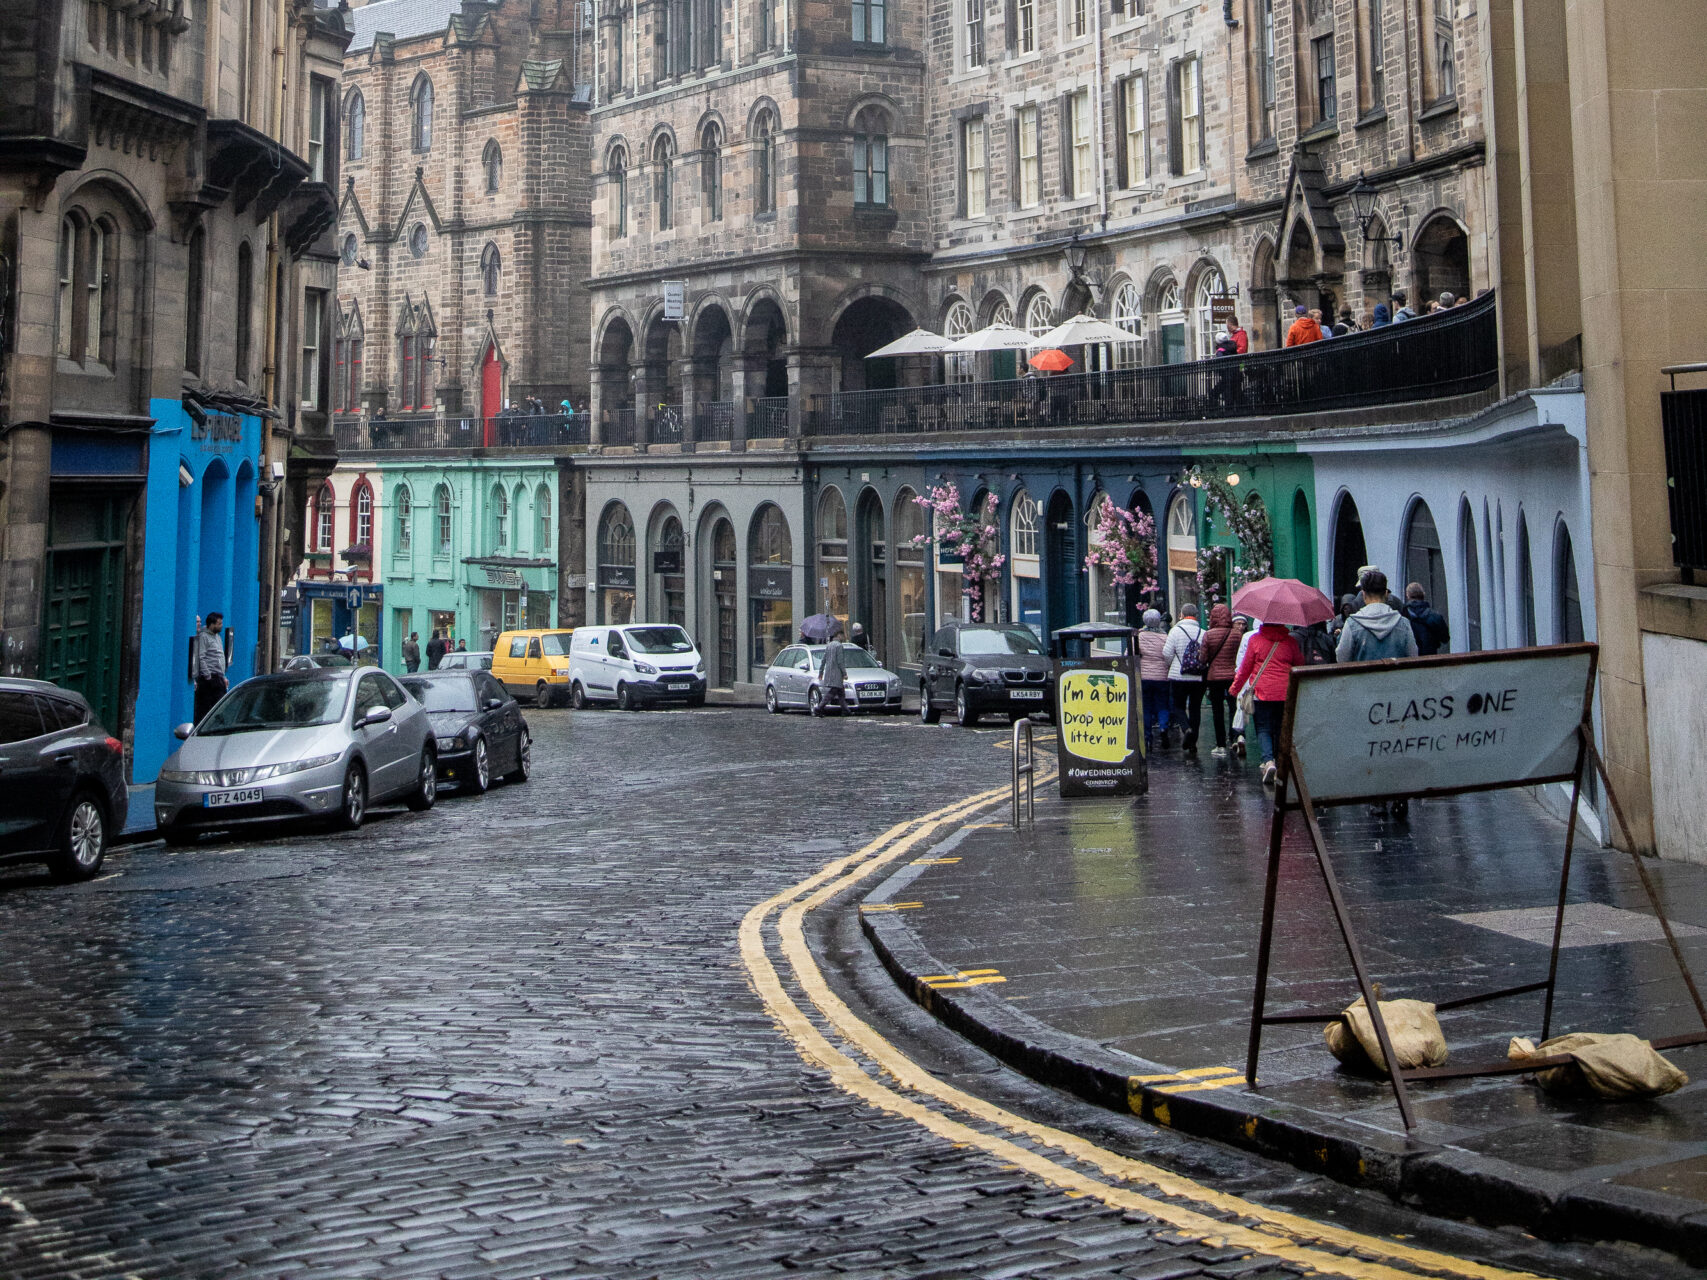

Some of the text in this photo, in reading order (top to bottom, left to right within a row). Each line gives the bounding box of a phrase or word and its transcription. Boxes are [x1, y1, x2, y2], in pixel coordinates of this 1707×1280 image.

[1064, 681, 1127, 703] I'm a bin
[1368, 689, 1517, 725] CLASS ONE
[1064, 711, 1125, 729] Drop your
[1071, 728, 1117, 745] litter in
[1368, 727, 1506, 757] TRAFFIC MGMT
[210, 789, 261, 805] OFZ 4049
